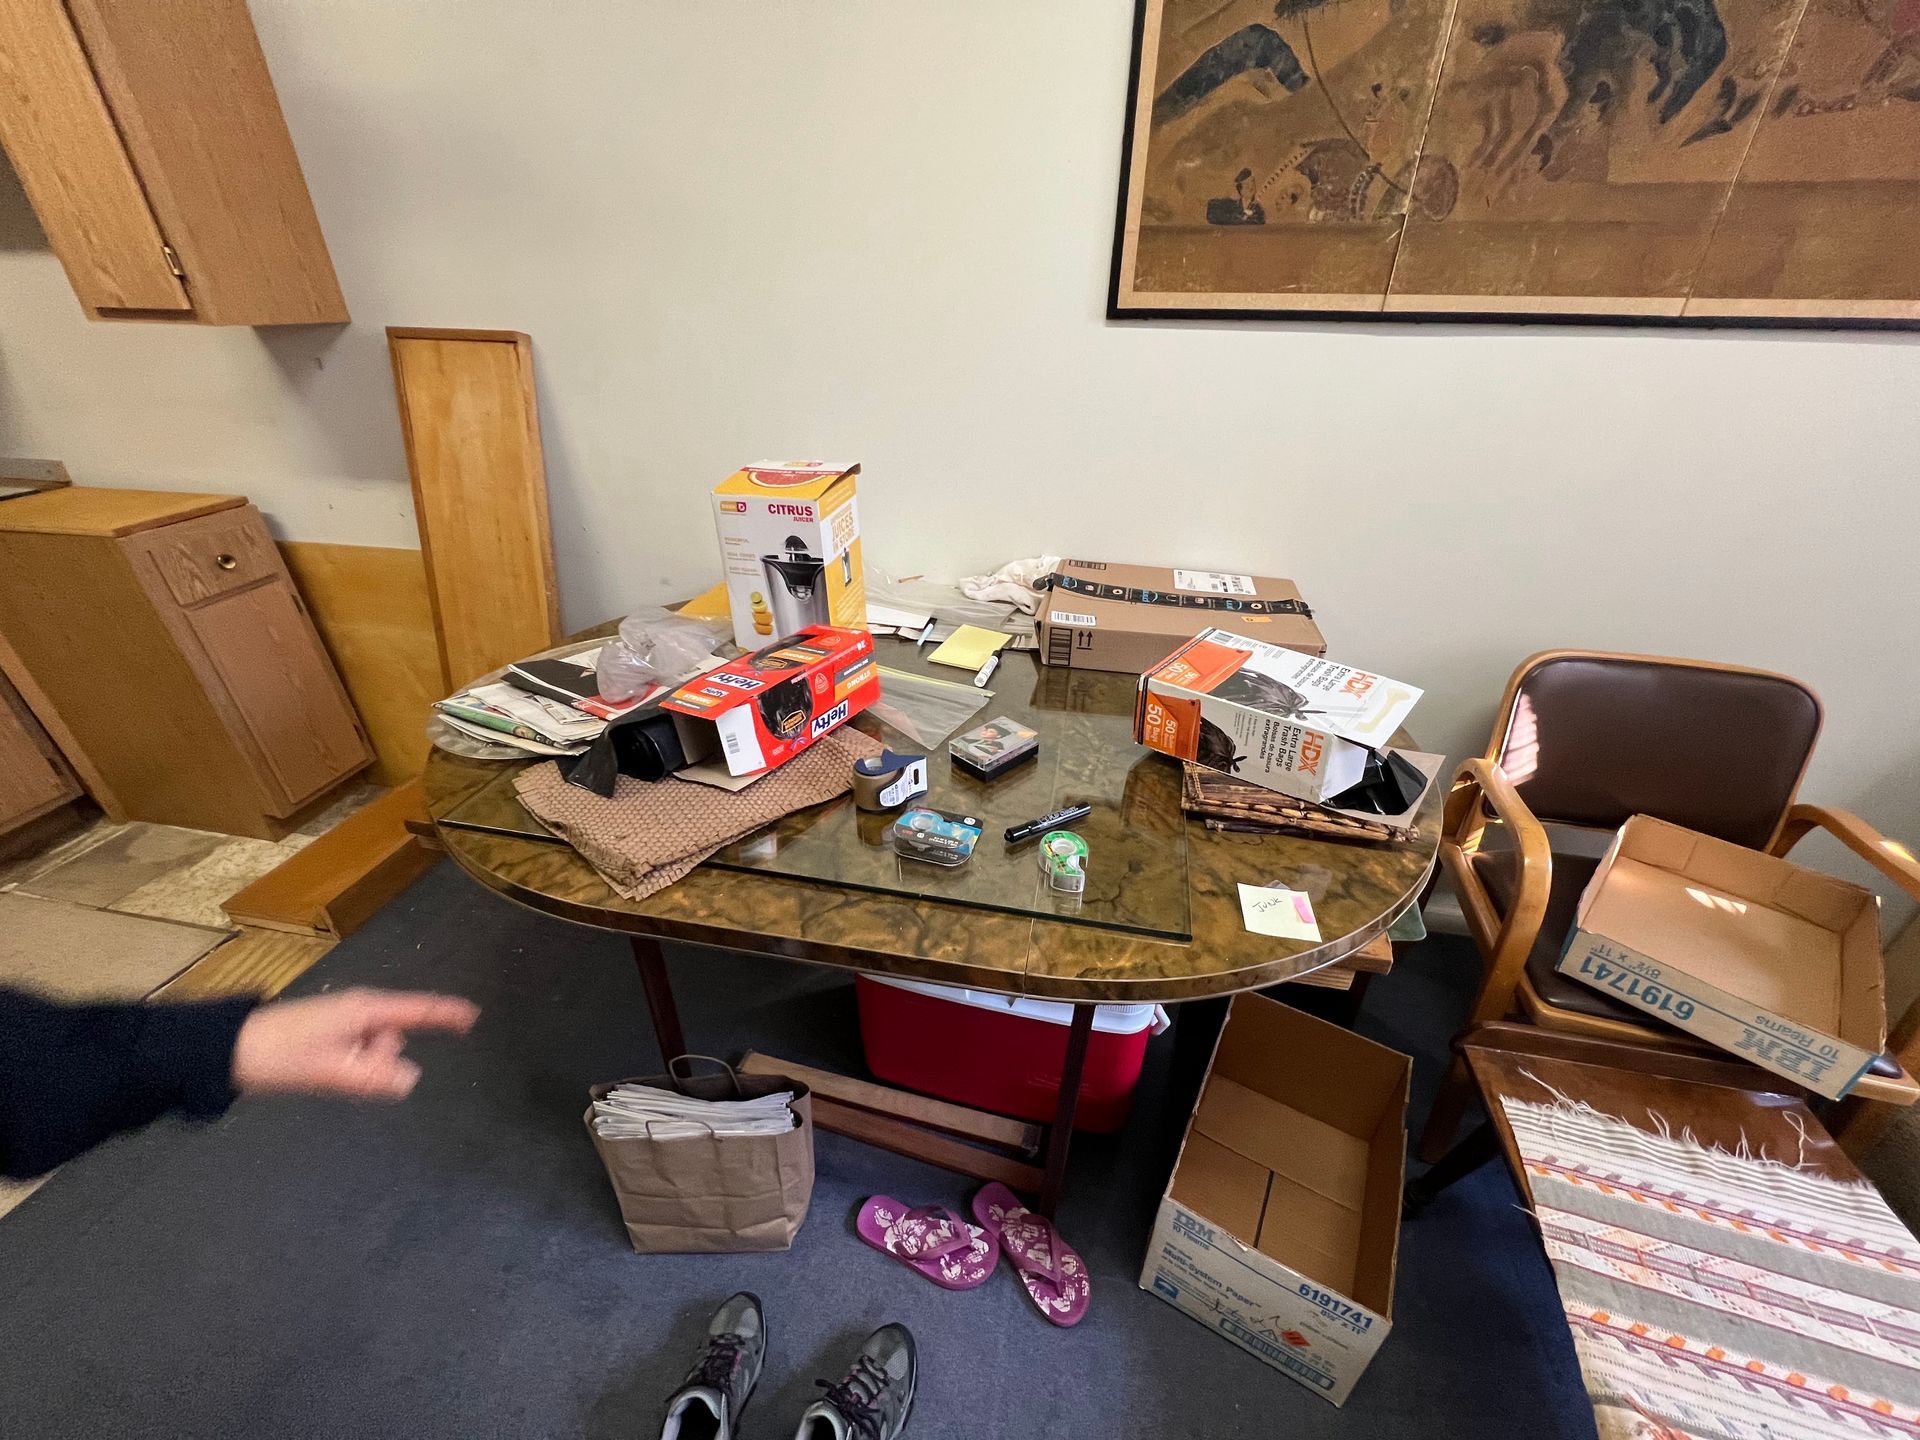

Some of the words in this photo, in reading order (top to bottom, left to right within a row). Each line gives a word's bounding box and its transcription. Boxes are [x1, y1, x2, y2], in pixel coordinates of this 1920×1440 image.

[768, 503, 813, 516] CITRUS
[1168, 662, 1188, 673] 50
[714, 673, 760, 688] Hefty
[847, 670, 871, 690] STRONG
[1339, 671, 1378, 699] HDX
[814, 703, 847, 732] Hefty
[1146, 703, 1163, 725] 50
[1165, 719, 1177, 734] 50
[1270, 721, 1280, 742] Bolsas
[1281, 725, 1292, 746] Trash
[1260, 719, 1271, 759] extragrandes
[1269, 743, 1275, 751] de
[1290, 727, 1301, 748] Extra
[1265, 752, 1274, 773] basura
[1275, 747, 1287, 767] Bags
[1285, 749, 1297, 771] Large
[1297, 731, 1324, 776] HDX
[1579, 955, 1695, 1021] 6191741
[1755, 1015, 1814, 1048] Reams
[1734, 1028, 1832, 1083] IBM
[1819, 1044, 1840, 1060] 10
[1174, 1209, 1216, 1243] IBM
[1183, 1230, 1210, 1251] Reams
[1163, 1246, 1222, 1288] Multi-System
[1299, 1283, 1374, 1329] 6191741
